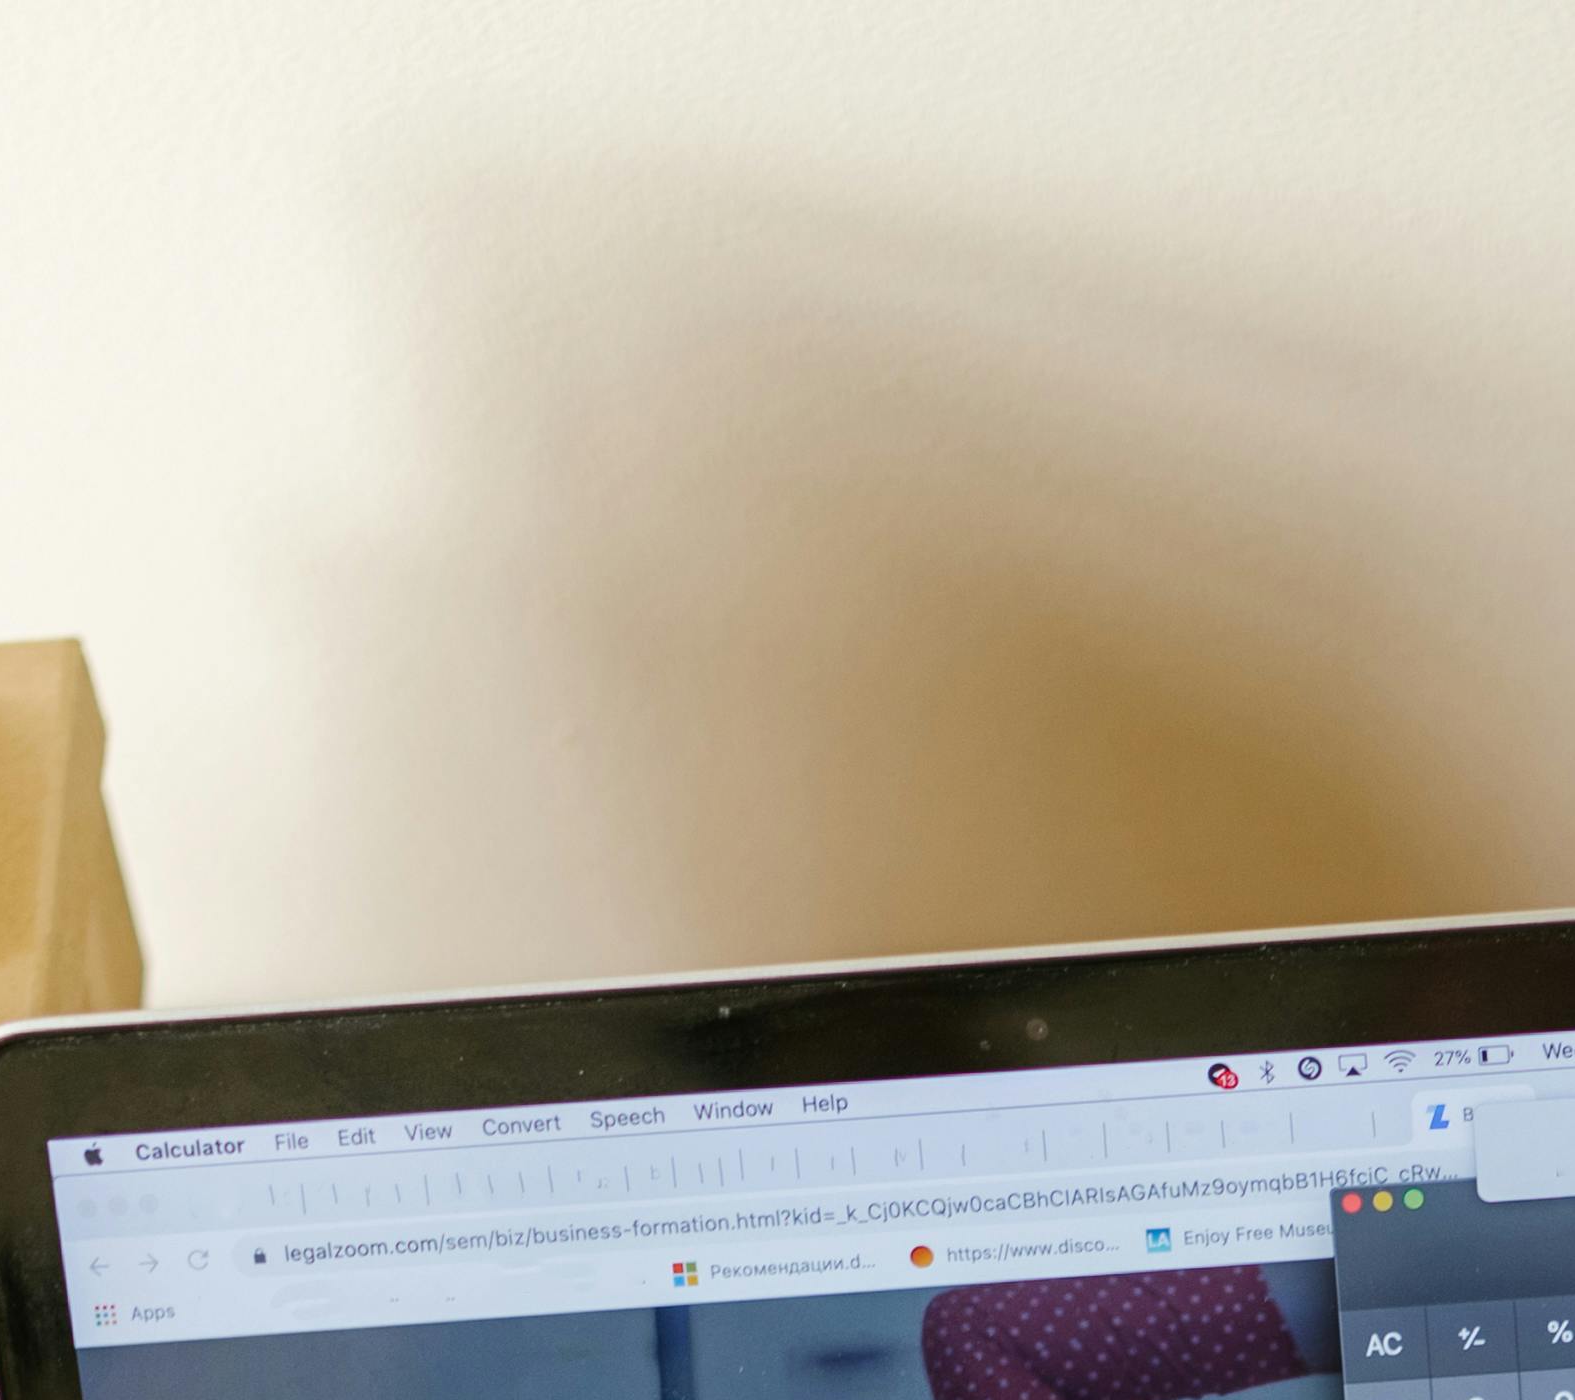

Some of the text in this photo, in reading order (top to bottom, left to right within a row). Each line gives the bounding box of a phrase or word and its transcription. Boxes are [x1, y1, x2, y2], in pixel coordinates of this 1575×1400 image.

[1434, 1049, 1472, 1067] 27%
[693, 1100, 774, 1121] Window
[802, 1093, 849, 1114] Help
[482, 1115, 562, 1137] Convert
[590, 1106, 666, 1131] Speech
[274, 1132, 309, 1151] File
[337, 1127, 376, 1147] Edit
[404, 1124, 453, 1142] View
[135, 1139, 245, 1161] Calculator
[1183, 1230, 1231, 1248] Enjoy
[1235, 1226, 1274, 1242] Free
[131, 1305, 176, 1323] Apps
[1365, 1331, 1403, 1357] AC
